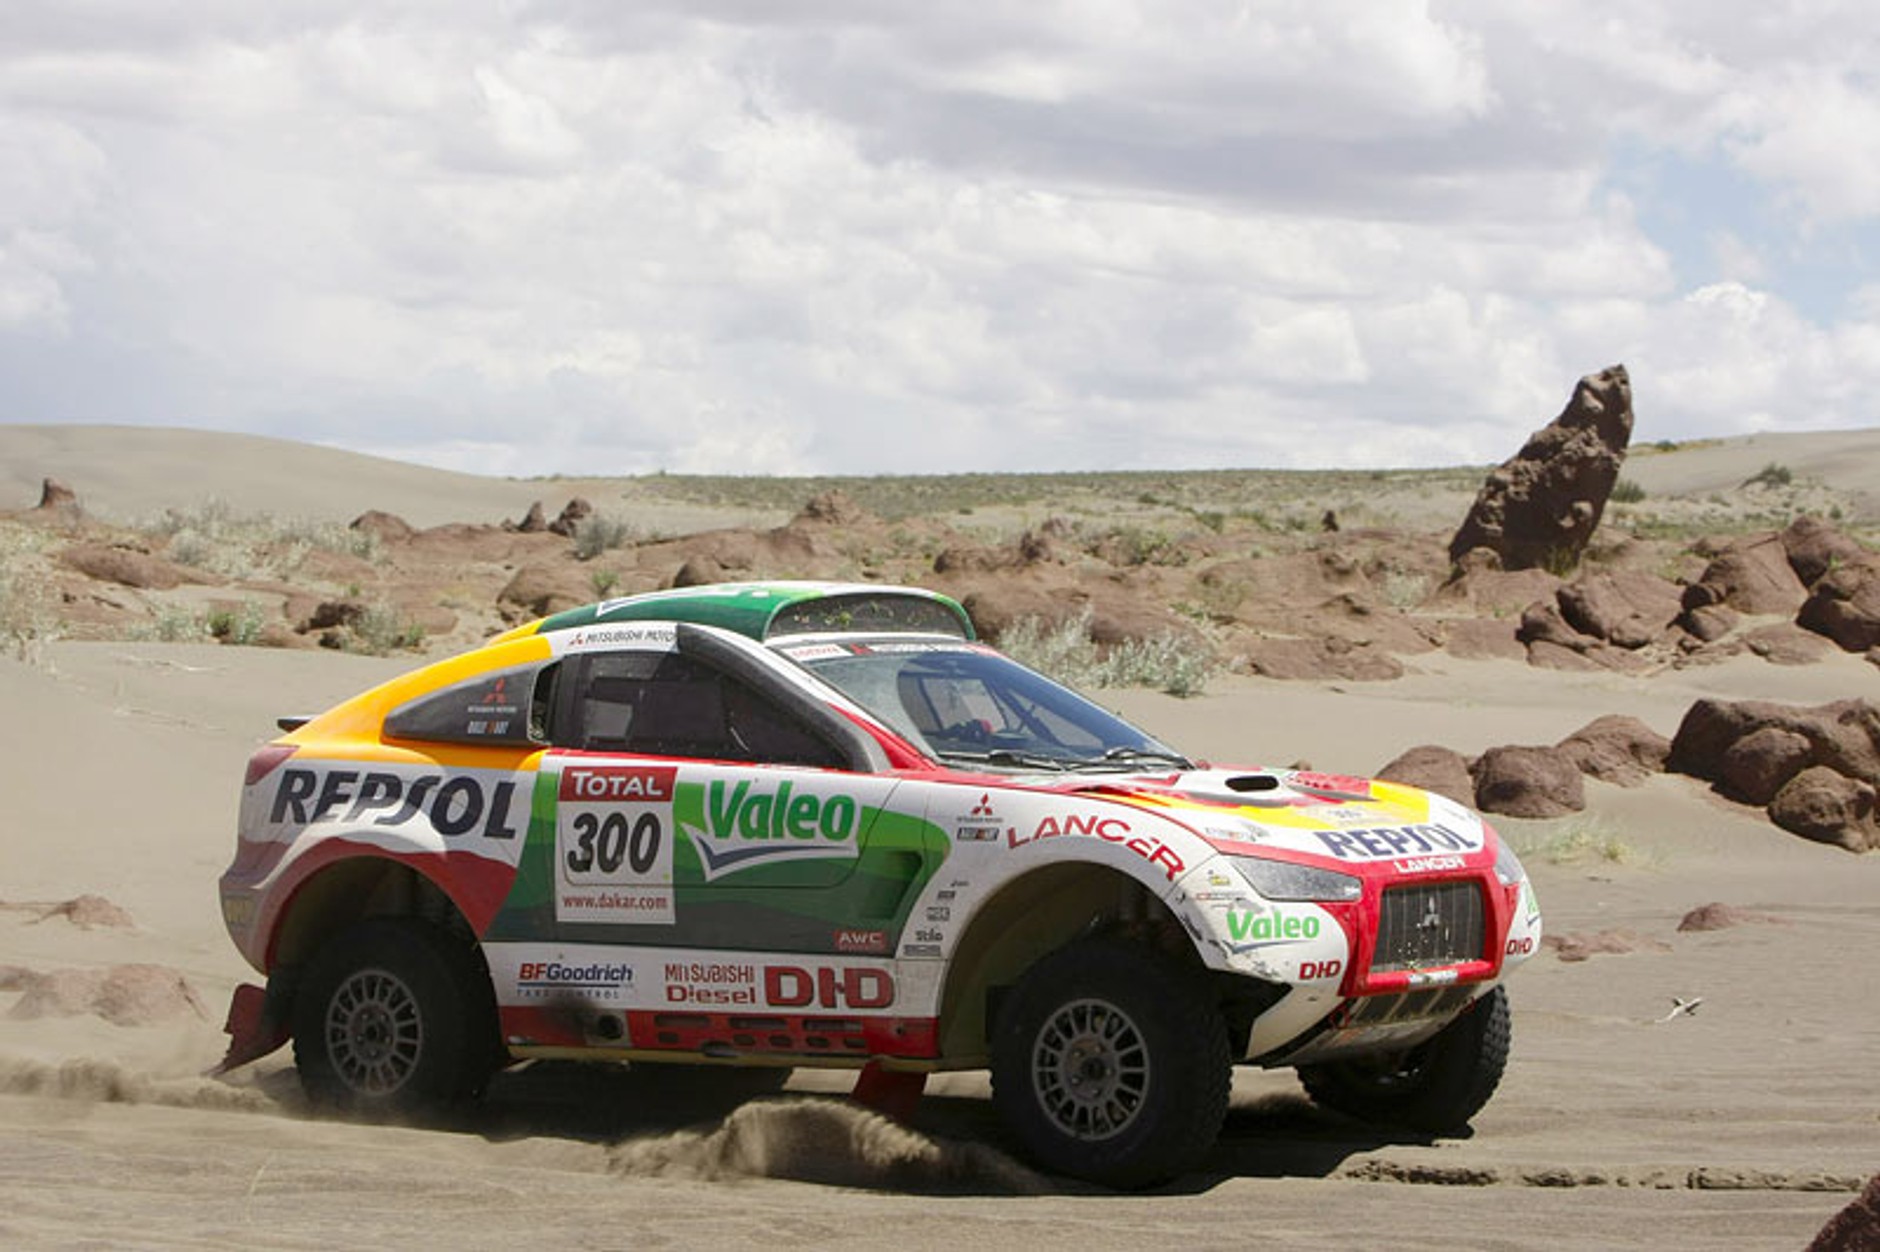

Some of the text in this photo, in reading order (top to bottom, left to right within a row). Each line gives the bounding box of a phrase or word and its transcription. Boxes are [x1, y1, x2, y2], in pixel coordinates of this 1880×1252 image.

[571, 771, 664, 797] TOTAL
[270, 768, 517, 839] REPSOL
[709, 779, 856, 842] Valeo
[567, 811, 662, 875] 300
[1006, 814, 1186, 882] LANCER
[1312, 823, 1479, 858] REPSOL
[1393, 856, 1467, 874] LANCER
[563, 893, 668, 910] www.dakar.com
[839, 931, 884, 945] AWC
[1226, 911, 1321, 941] Valeo
[518, 962, 634, 982] BFGoodrich
[664, 963, 755, 984] MITSUBISHI
[665, 984, 757, 1005] Diesel
